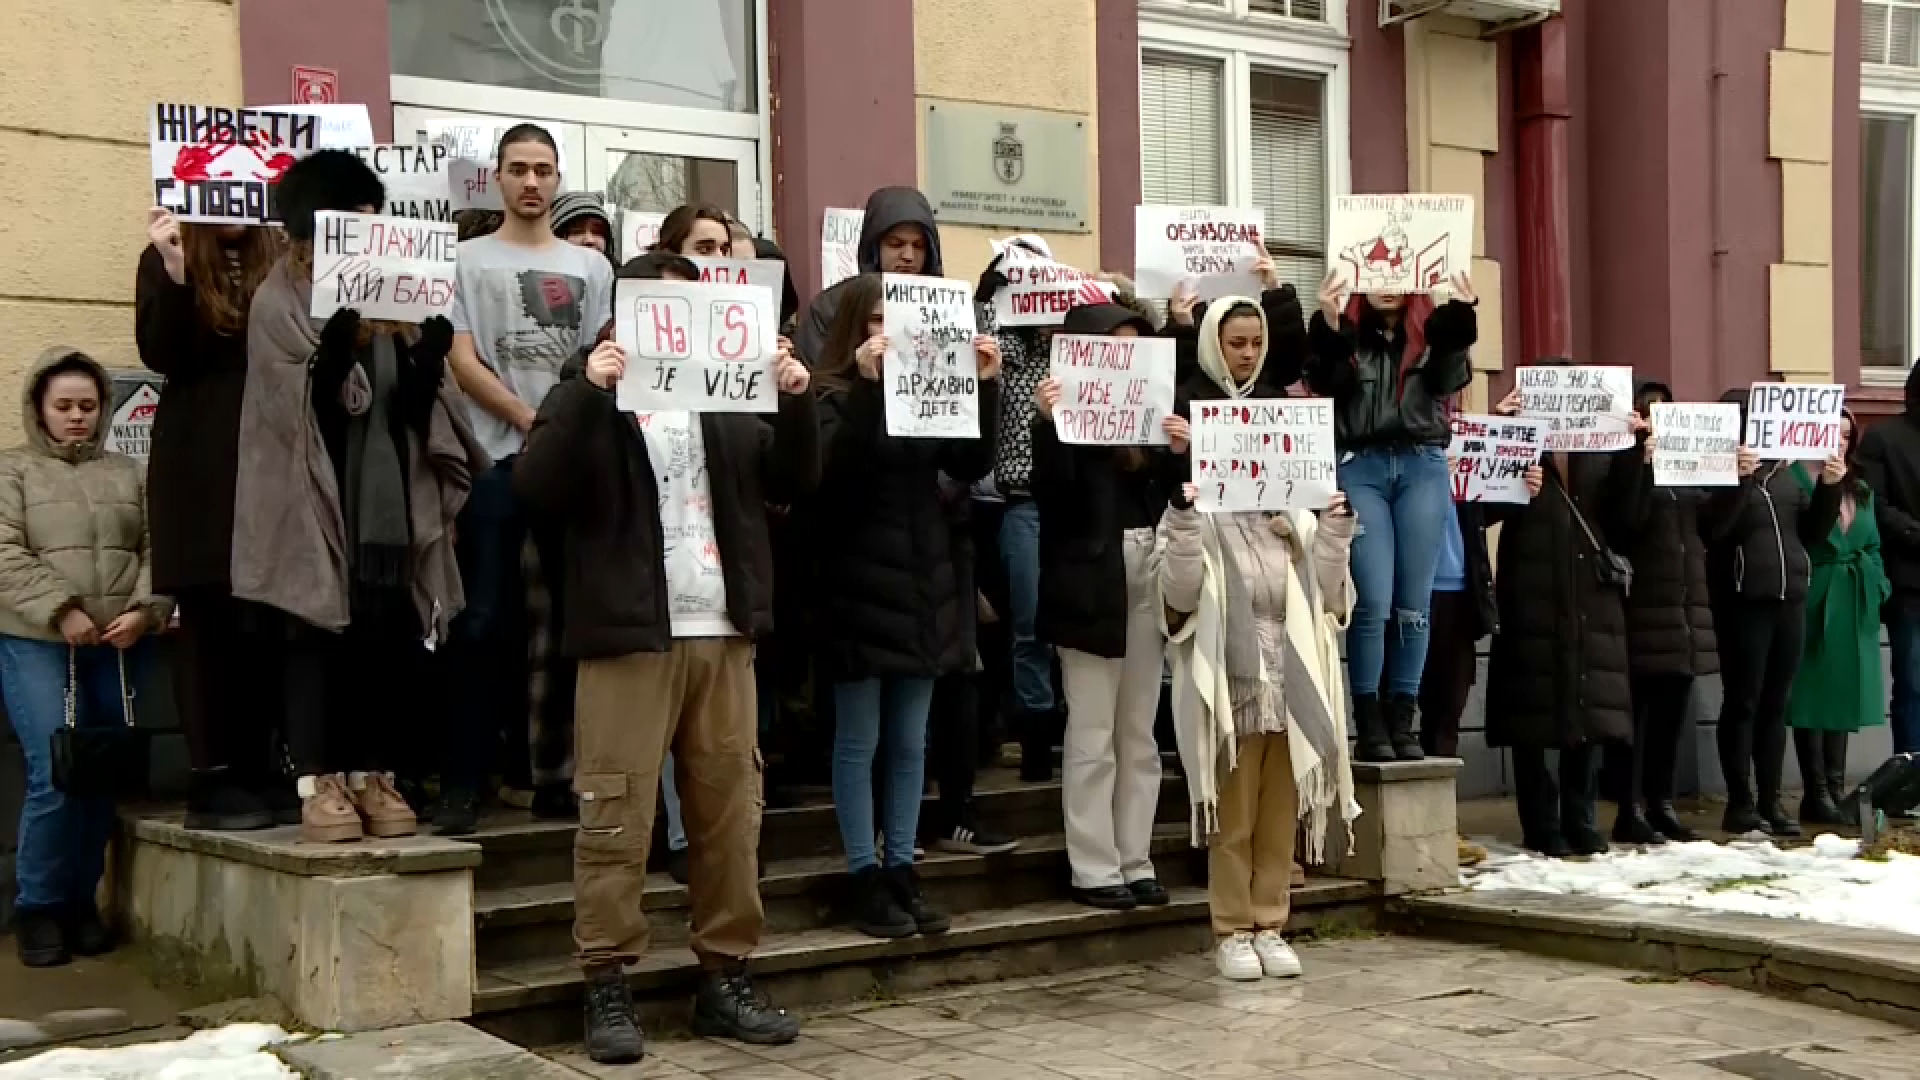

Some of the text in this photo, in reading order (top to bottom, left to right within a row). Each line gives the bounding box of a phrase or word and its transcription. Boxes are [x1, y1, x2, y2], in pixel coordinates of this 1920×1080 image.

[157, 102, 316, 149] ЖИВЕТИ
[325, 217, 457, 262] НЕ ЛАЖИТЕ
[335, 272, 457, 307] МИ БАБУ
[886, 282, 966, 306] ИНСТИТУТ
[919, 306, 941, 325] ЗА
[717, 303, 748, 360] S
[947, 351, 957, 367] И
[651, 361, 763, 401] JE VIŠE
[895, 372, 975, 397] ДРЖАВНО
[917, 399, 959, 419] ДЕТЕ
[1751, 386, 1843, 414] ПРОТЕСТ
[1201, 405, 1329, 427] PREPOZNAJETE
[1201, 431, 1317, 455] LI SIMPTOME
[1748, 419, 1774, 448] ЈЕ
[1780, 420, 1839, 448] ИСПИТ
[1198, 459, 1335, 481] RASPADA SISTEMA
